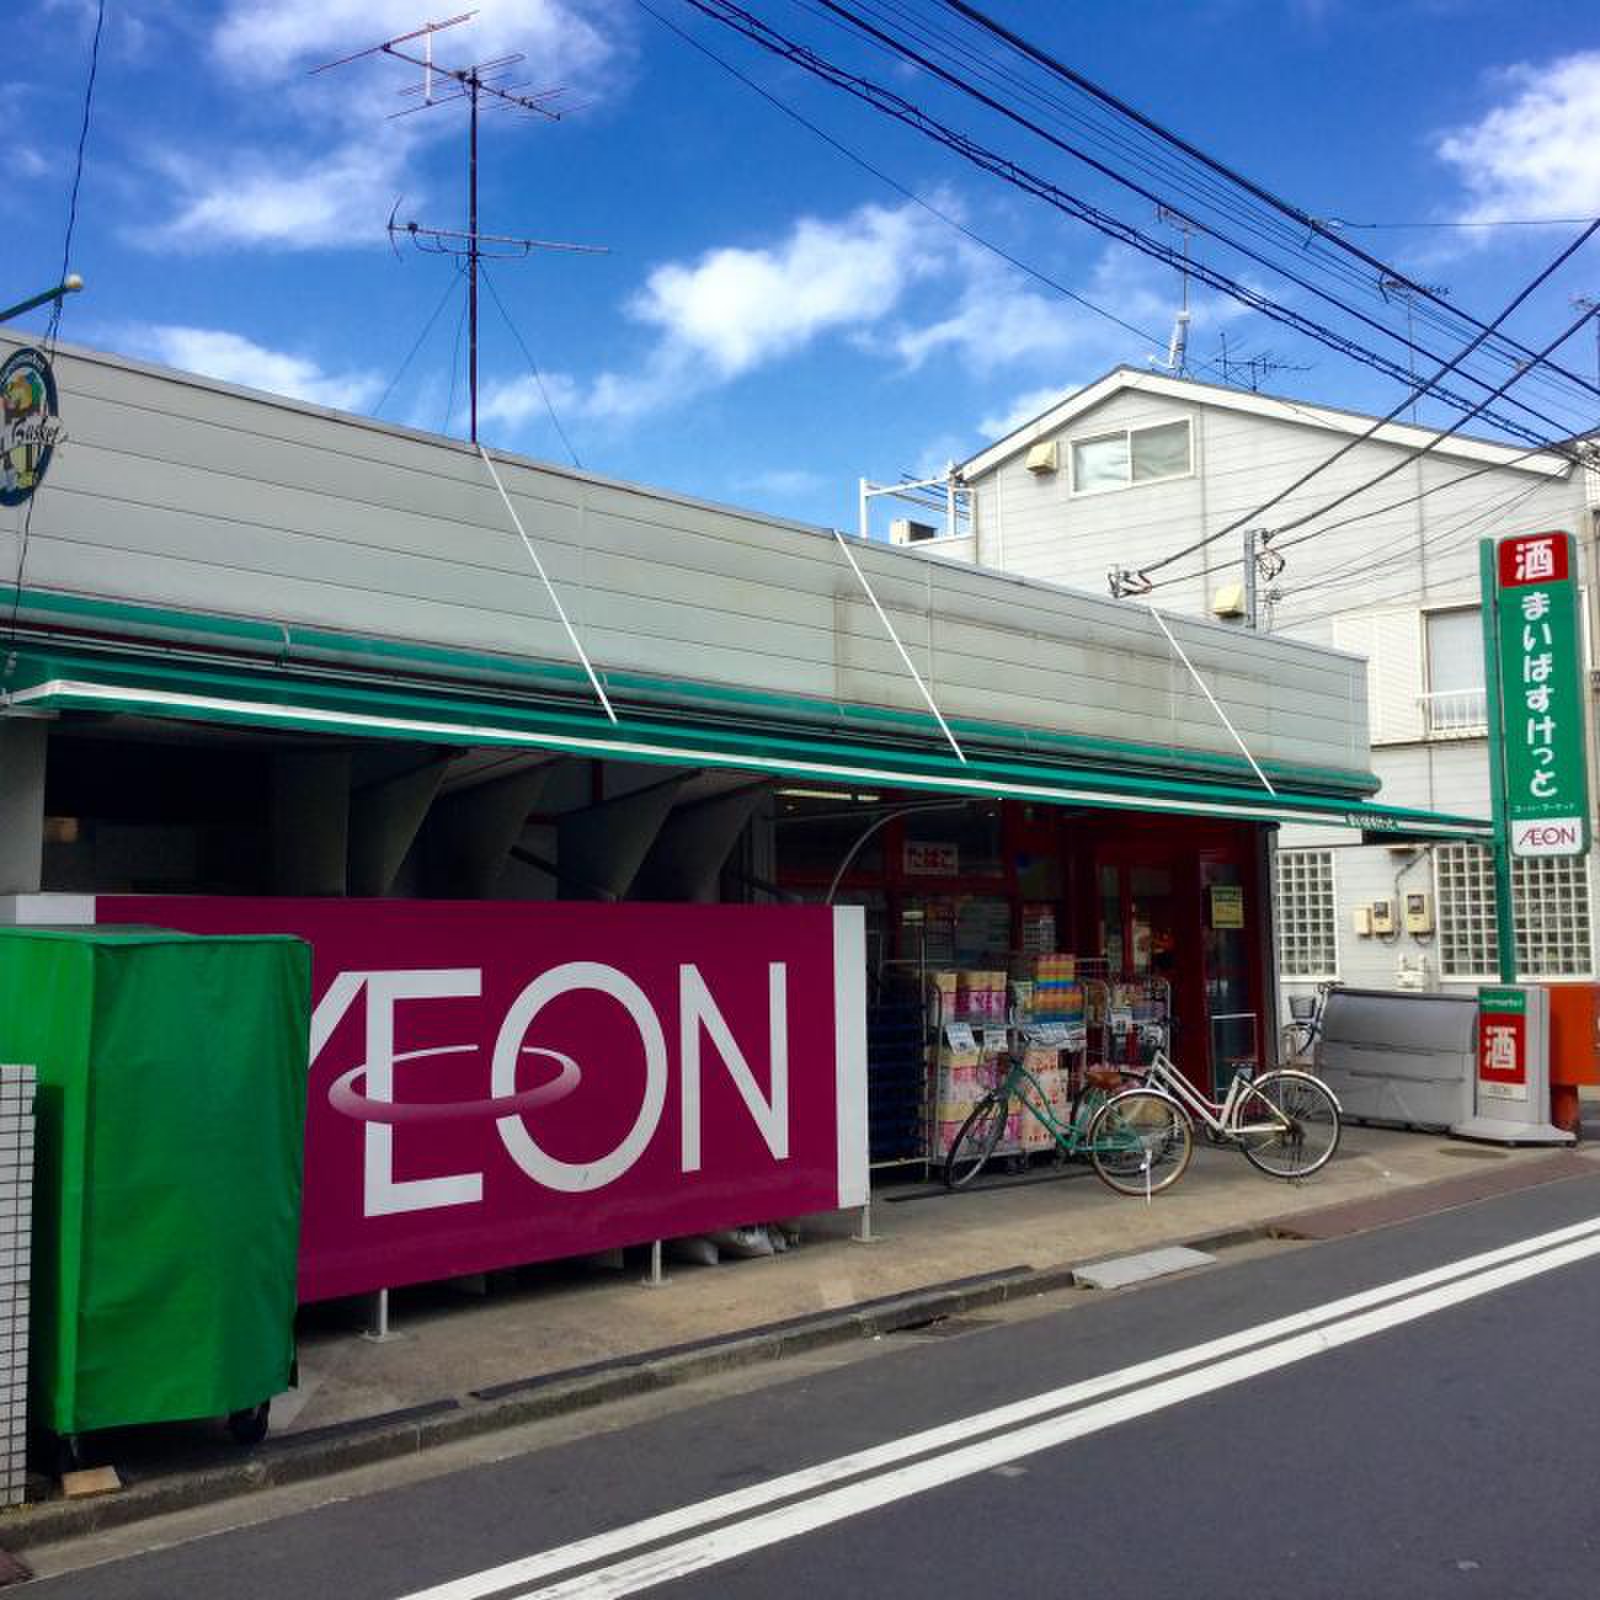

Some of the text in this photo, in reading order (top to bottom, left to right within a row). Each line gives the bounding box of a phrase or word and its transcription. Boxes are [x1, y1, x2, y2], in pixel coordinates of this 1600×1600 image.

[1515, 538, 1554, 580] 酒
[1521, 591, 1558, 797] まいばすけっと
